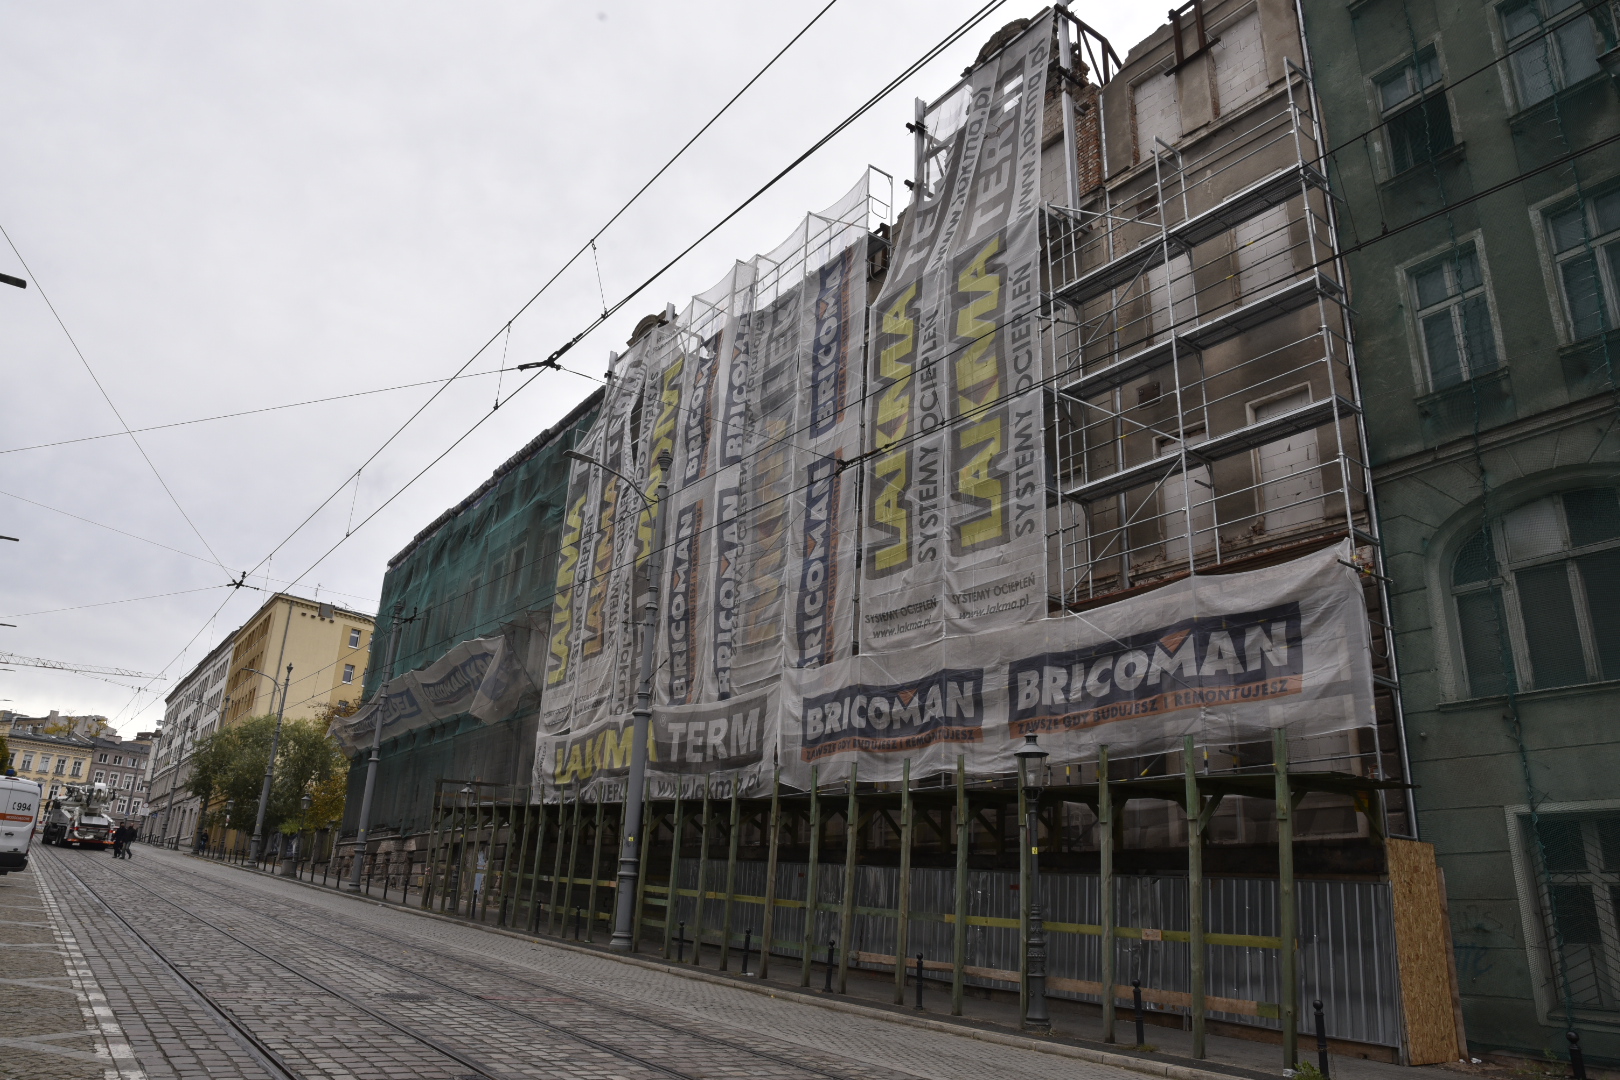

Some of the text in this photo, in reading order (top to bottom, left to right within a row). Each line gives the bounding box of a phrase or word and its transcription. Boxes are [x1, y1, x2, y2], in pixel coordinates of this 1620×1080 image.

[1017, 37, 1049, 219] www.lakma.pl
[931, 85, 994, 268] www.lakma.pl
[874, 283, 917, 571] LAKMA
[956, 234, 1001, 547] LAKMA
[1007, 261, 1035, 537] SYSTEMY OCIEPLEŃ
[917, 447, 938, 562] SYSTEMY
[548, 493, 587, 685] LAKMA
[671, 511, 693, 698] BRICOMAN
[865, 609, 899, 624] SYSTEMY
[951, 572, 1036, 606] SYSTEMY OCIEPLEŃ
[959, 594, 1030, 619] www.lakma.pl
[873, 615, 932, 638] www.lakma.pl
[1017, 621, 1288, 710] BRICOMAN
[667, 707, 760, 763] TERM
[806, 681, 975, 740] BRICOMAN
[1018, 716, 1058, 734] ZAWSZE
[1063, 713, 1088, 731] GDY
[1093, 698, 1157, 724] BUDUJESZ
[1173, 679, 1288, 709] REMONTUJESZ
[806, 743, 835, 760] ZAWSZE
[837, 740, 850, 753] GDY
[852, 736, 898, 752] BUDUJESZ
[905, 728, 975, 749] REMONTUJESZ
[17, 802, 32, 811] 994
